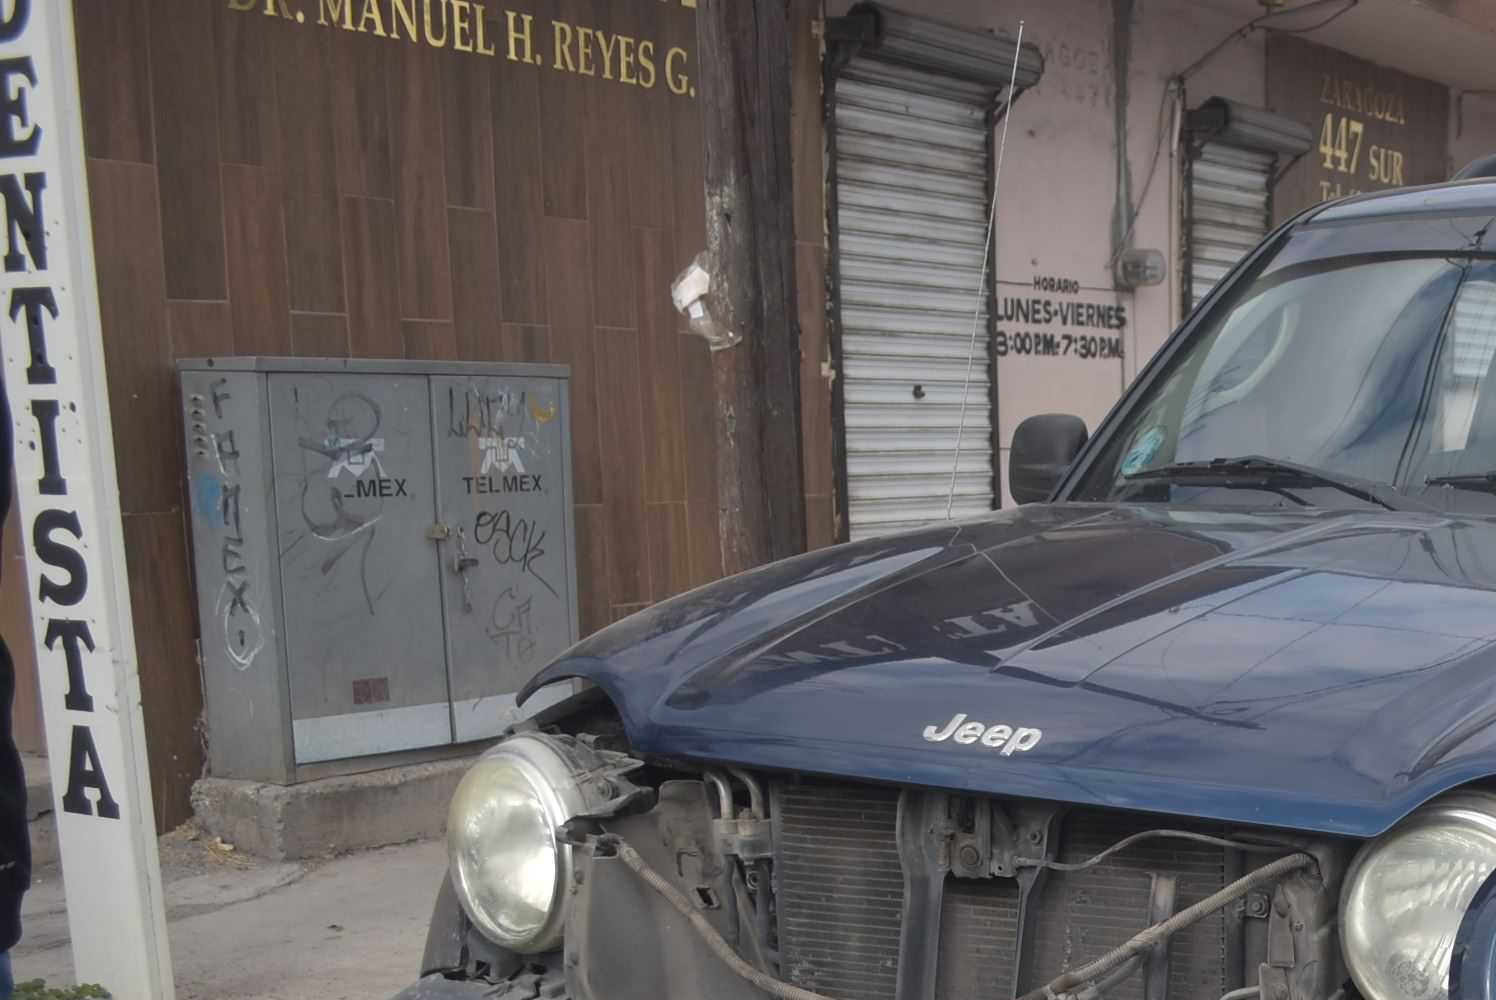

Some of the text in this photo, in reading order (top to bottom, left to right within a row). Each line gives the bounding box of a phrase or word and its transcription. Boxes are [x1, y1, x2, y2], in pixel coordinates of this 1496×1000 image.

[316, 0, 495, 56] MANUEL
[505, 10, 543, 66] H.
[551, 20, 656, 88] REYES
[665, 47, 696, 97] G.
[1319, 112, 1404, 185] 447 SUR
[1032, 276, 1080, 294] HORARIO
[462, 475, 543, 494] TELMEX
[923, 713, 1043, 757] Jeep
